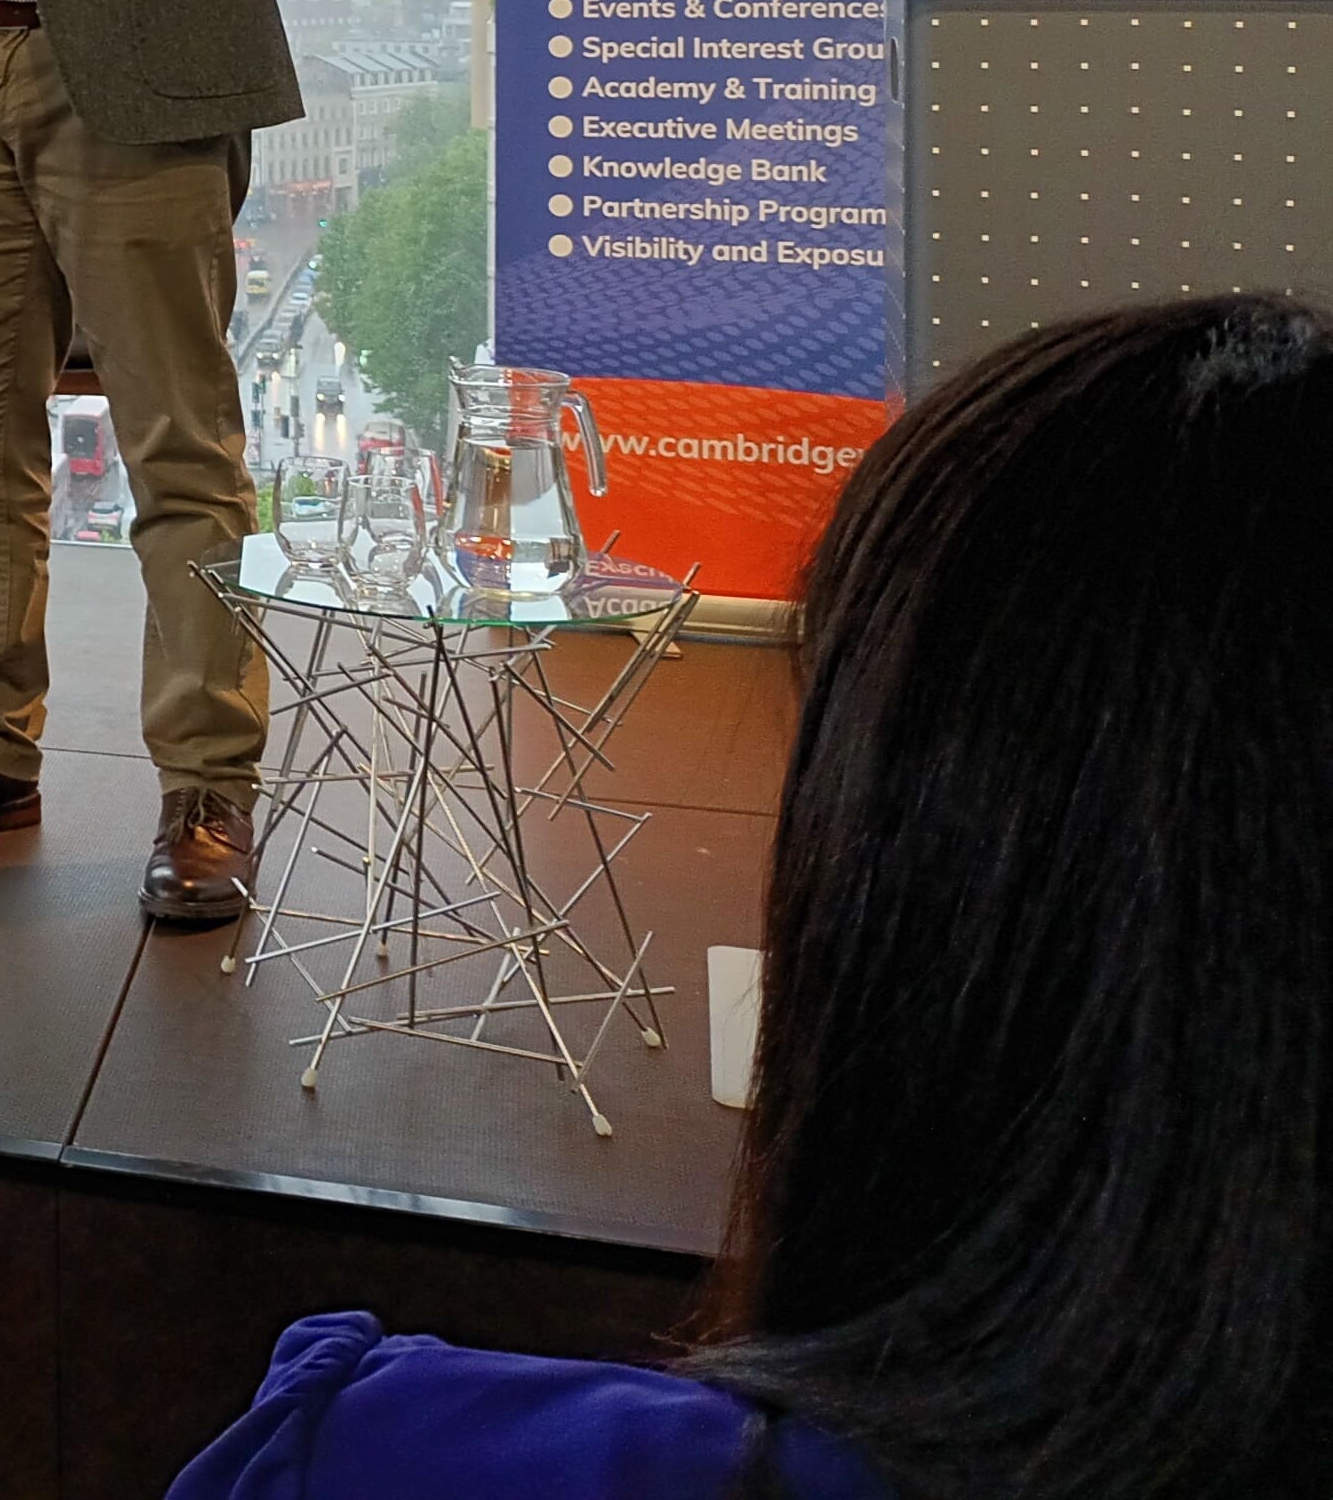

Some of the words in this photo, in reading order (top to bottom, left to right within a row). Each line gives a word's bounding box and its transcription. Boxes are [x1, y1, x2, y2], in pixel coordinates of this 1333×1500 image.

[581, 35, 687, 63] Special
[693, 37, 804, 60] Interest
[581, 76, 715, 104] Academy
[724, 78, 745, 100] &
[753, 78, 877, 106] Training
[583, 116, 717, 140] Executive
[726, 118, 859, 146] Meetings
[583, 156, 742, 186] Knowledge
[751, 159, 827, 182] Bank
[583, 195, 750, 227] Partnership
[581, 235, 704, 265] Visibility
[712, 240, 768, 263] and
